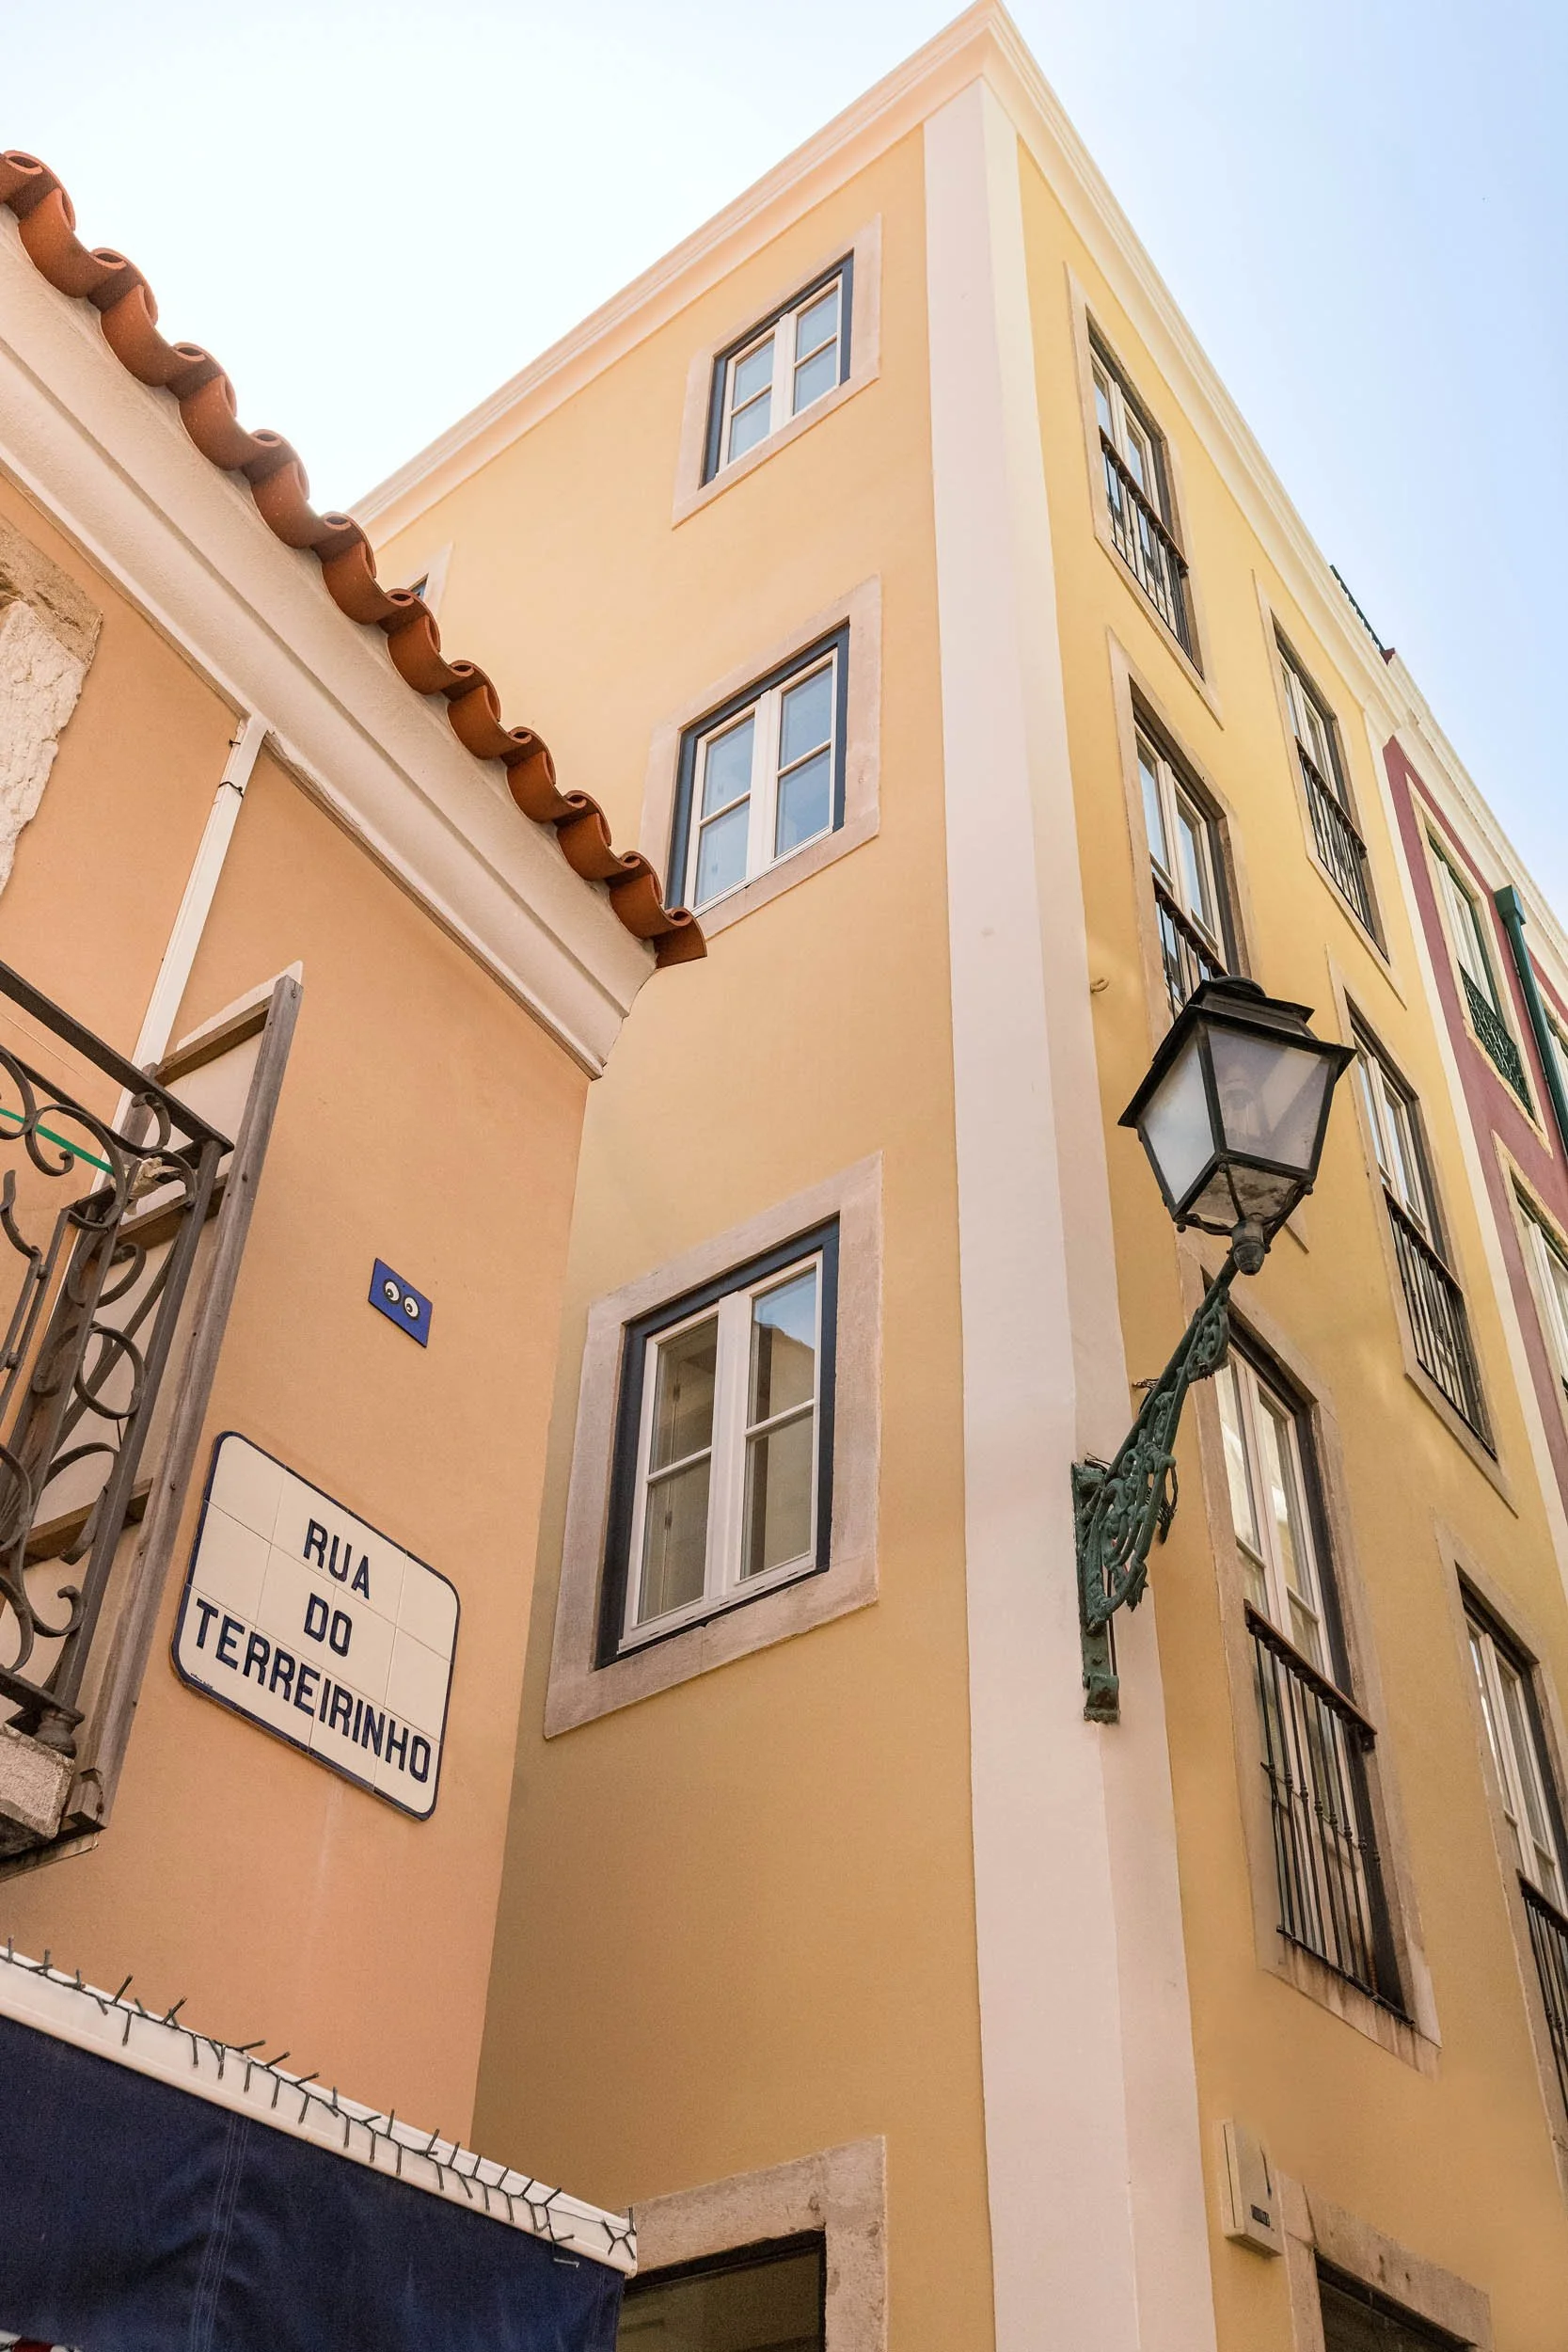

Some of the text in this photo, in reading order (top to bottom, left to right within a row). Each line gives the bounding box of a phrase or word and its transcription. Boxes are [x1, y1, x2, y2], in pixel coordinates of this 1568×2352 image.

[303, 1518, 371, 1599] RUA
[303, 1593, 353, 1657] DO
[196, 1597, 432, 1783] TERREIRINHO
